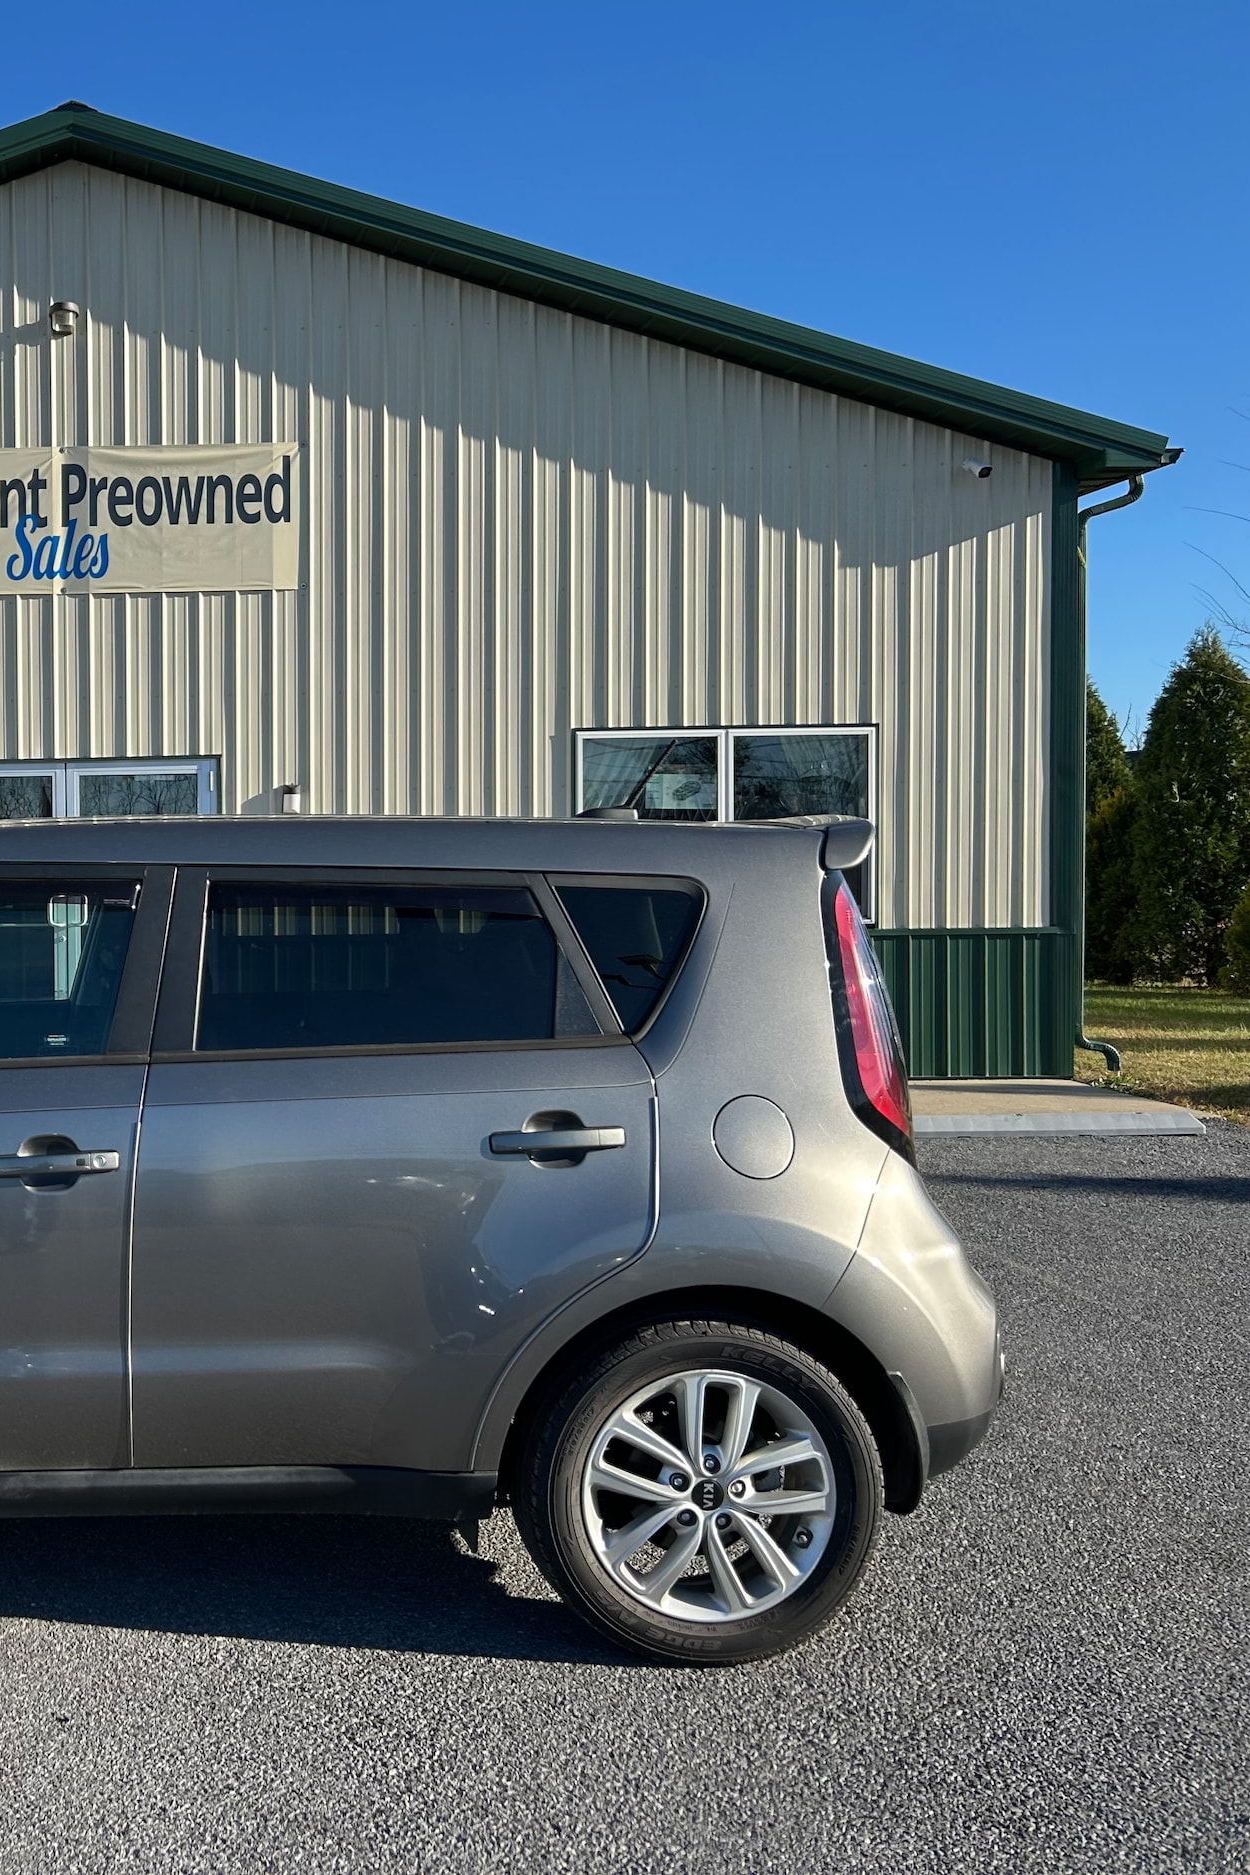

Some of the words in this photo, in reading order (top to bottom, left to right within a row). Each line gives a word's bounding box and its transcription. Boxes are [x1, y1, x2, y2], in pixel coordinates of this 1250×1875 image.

[61, 456, 291, 527] Preowned
[6, 514, 109, 580] Sales
[703, 1483, 714, 1508] KIA
